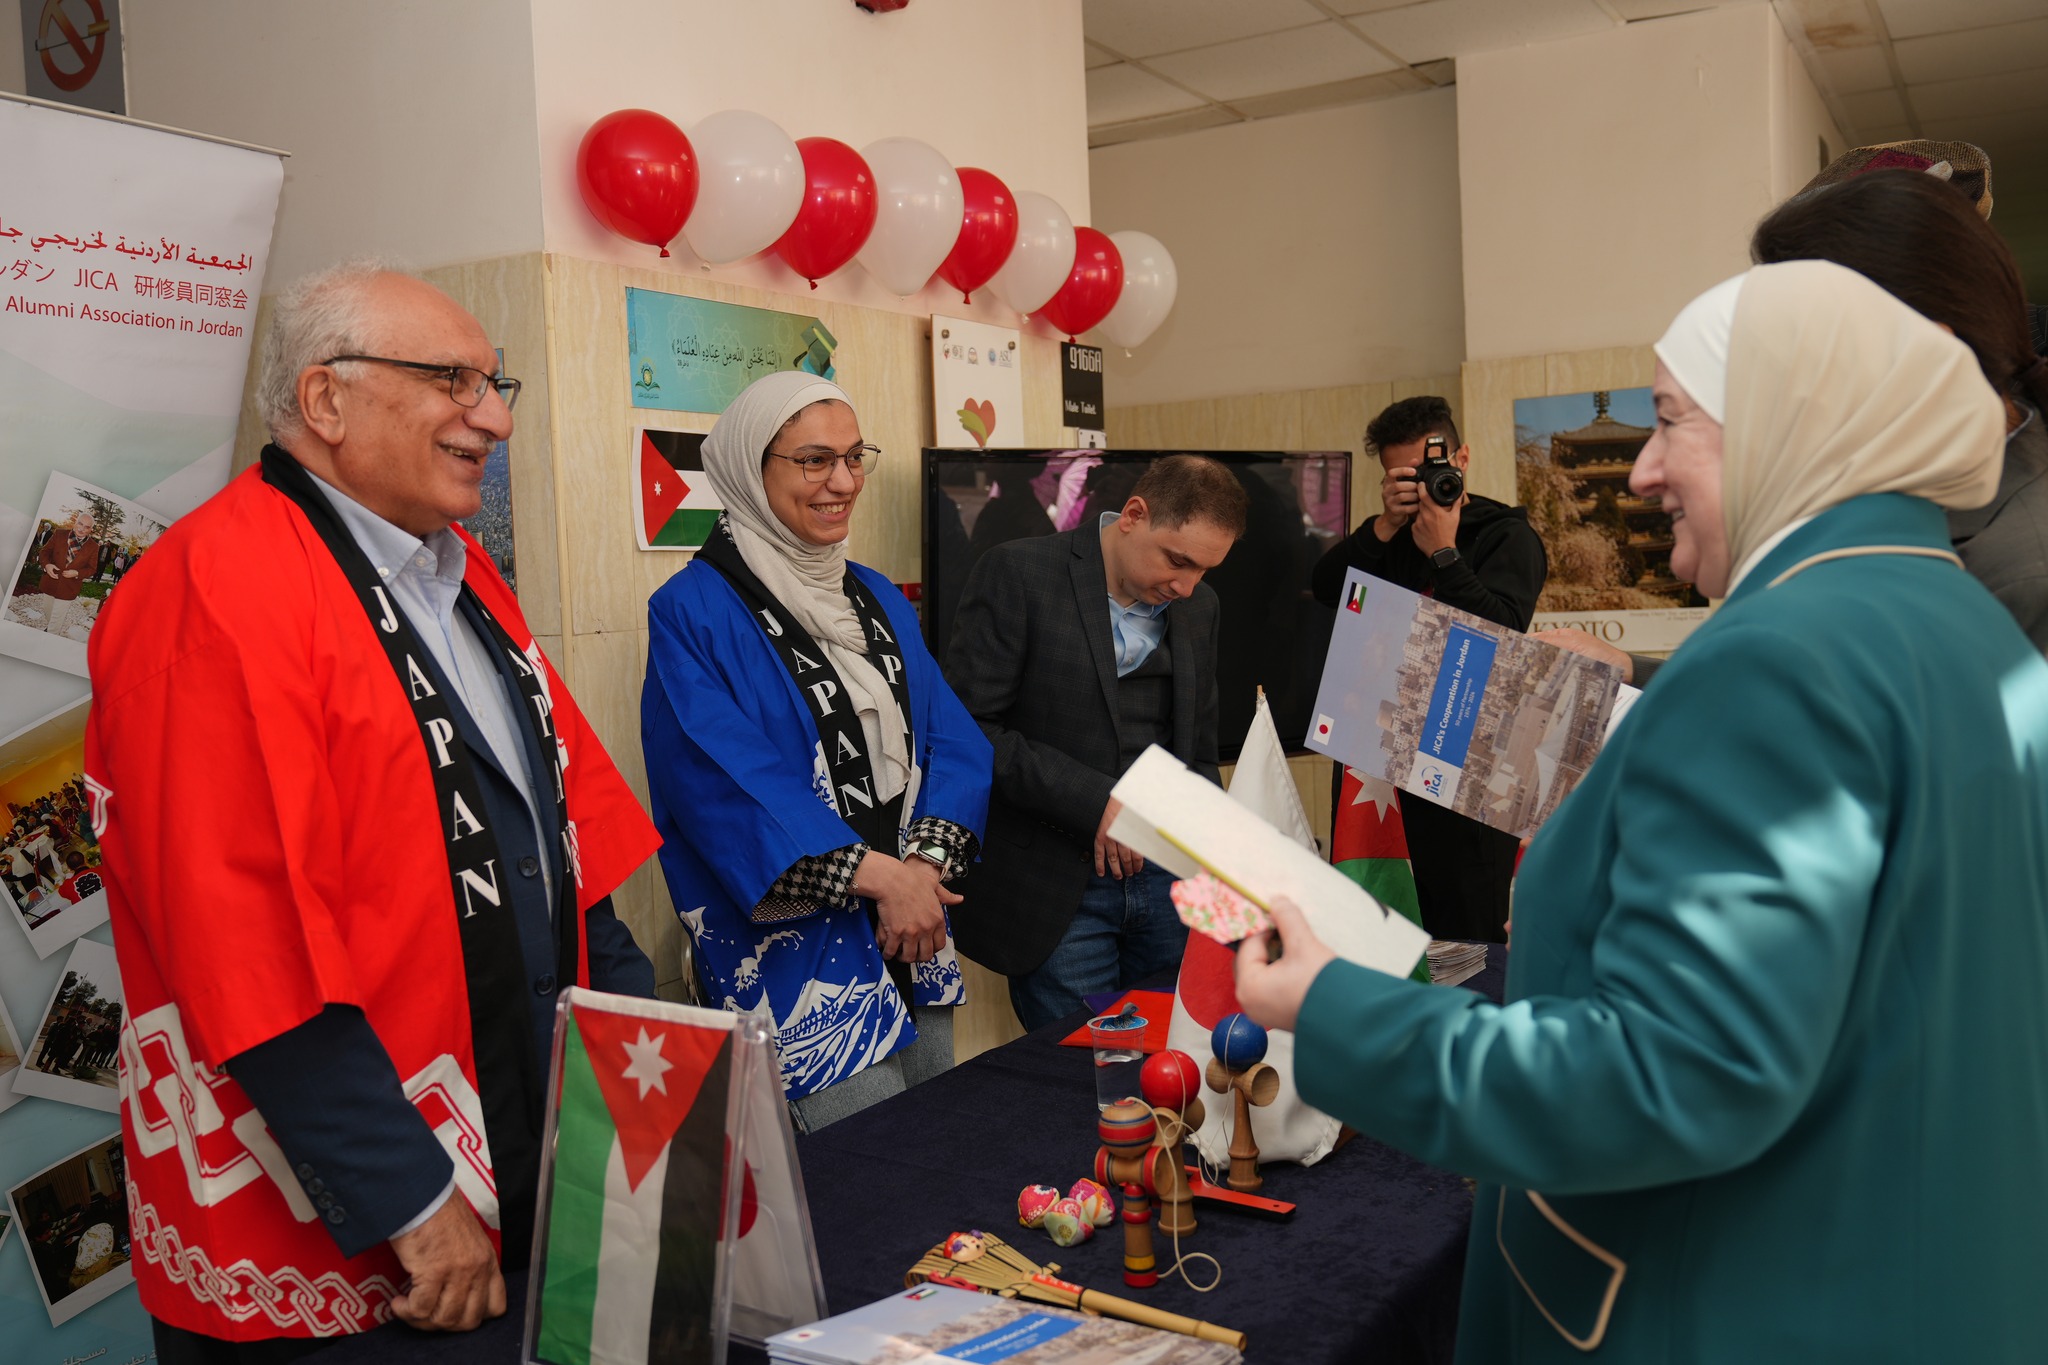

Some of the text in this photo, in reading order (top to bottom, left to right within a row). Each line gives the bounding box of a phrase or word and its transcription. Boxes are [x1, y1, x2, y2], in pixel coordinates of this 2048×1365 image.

[30, 231, 108, 253] لخريجي
[115, 236, 180, 264] الأردنية
[186, 247, 253, 275] الجمعية
[74, 268, 118, 292] JICA
[134, 275, 248, 310] 研修員同窓会
[5, 296, 243, 338] Alumni Association in Jordan
[1456, 638, 1470, 669] Jordan
[757, 606, 874, 818] JAPAN
[1439, 678, 1459, 729] Cooperation
[371, 586, 501, 918] JAPAN
[1432, 729, 1447, 755] JICA's
